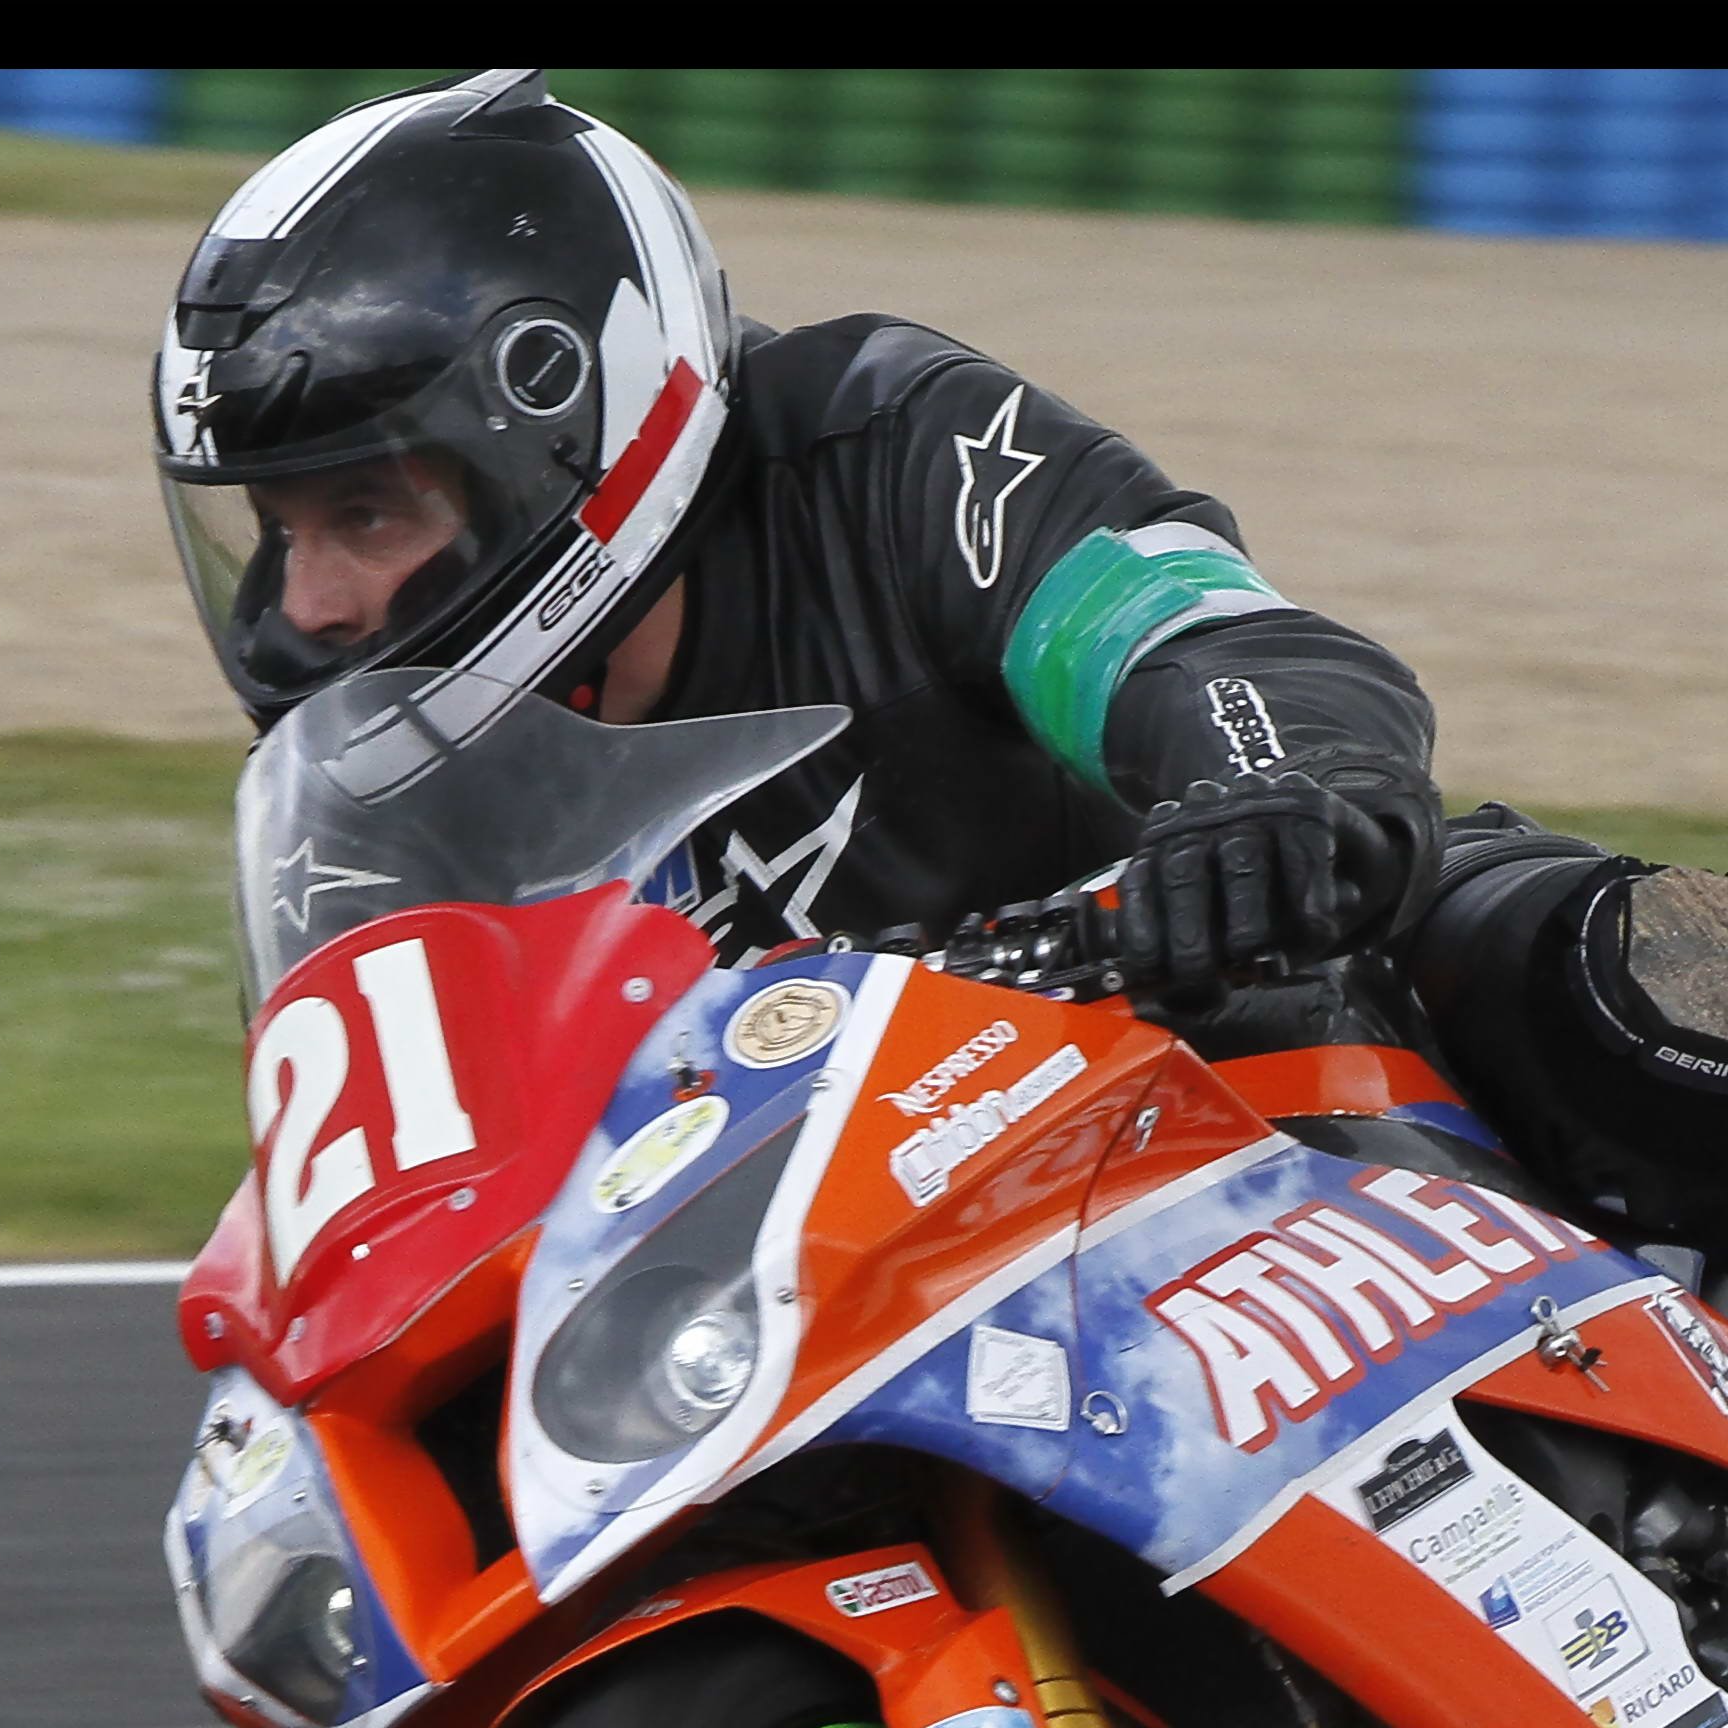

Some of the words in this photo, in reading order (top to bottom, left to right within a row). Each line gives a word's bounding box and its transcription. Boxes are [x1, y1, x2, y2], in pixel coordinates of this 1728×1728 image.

[247, 937, 478, 1291] 21
[873, 1019, 1020, 1117] NESPRESSO
[1623, 1664, 1696, 1724] RICARD
